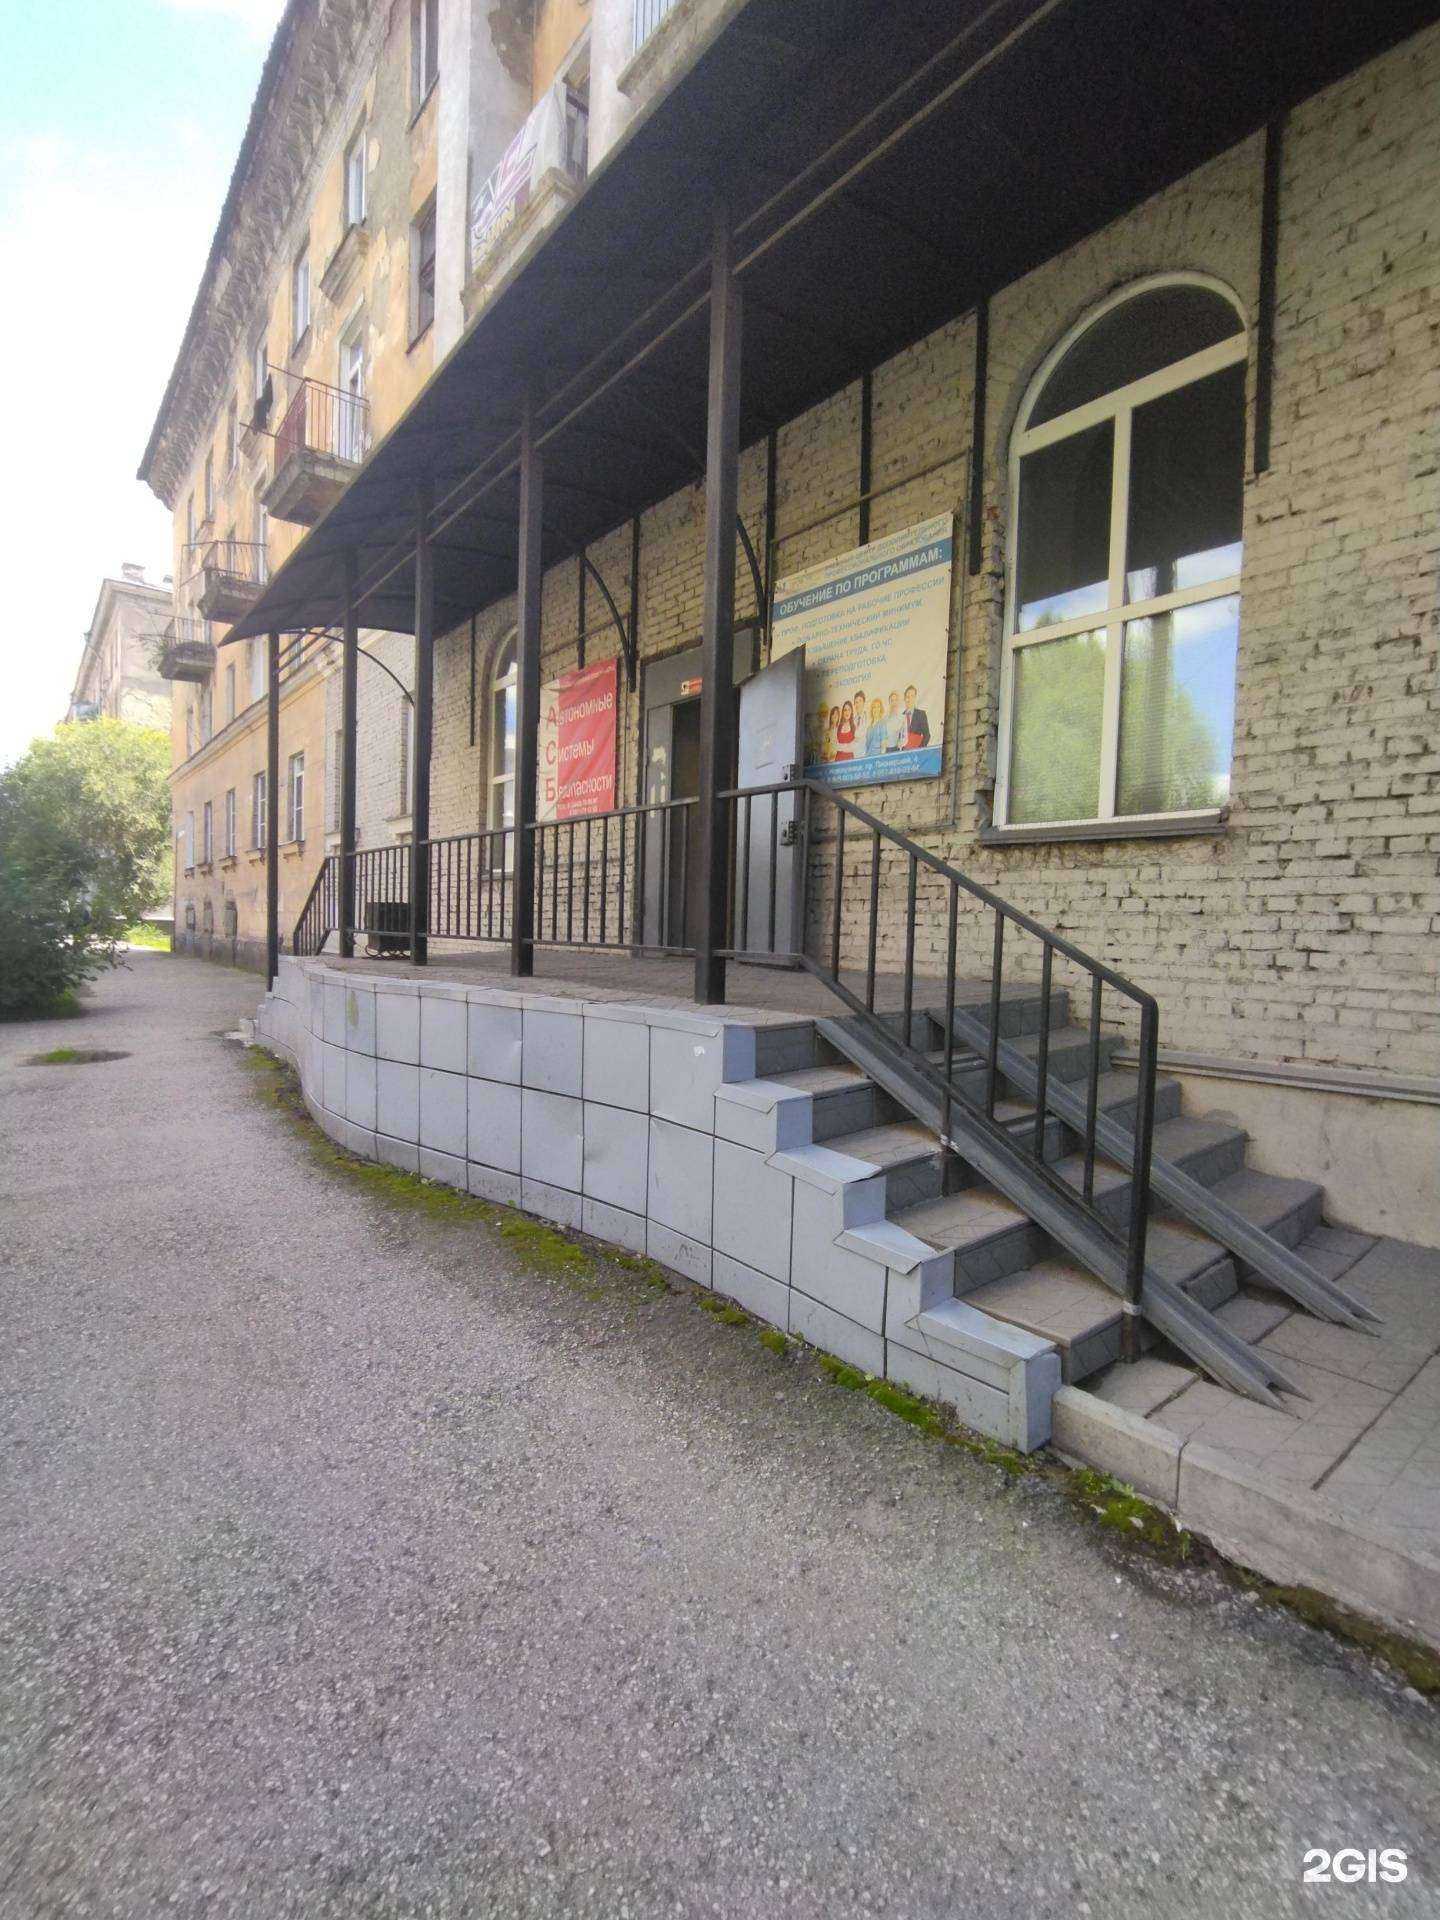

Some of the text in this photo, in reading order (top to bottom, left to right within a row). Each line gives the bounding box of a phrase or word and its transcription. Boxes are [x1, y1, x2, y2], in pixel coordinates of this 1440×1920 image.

[779, 586, 833, 616] ОБУЧЕНИЕ
[835, 580, 852, 598] ПО
[854, 547, 943, 589] ПРОГРАММАМ:
[545, 738, 594, 767] Системы
